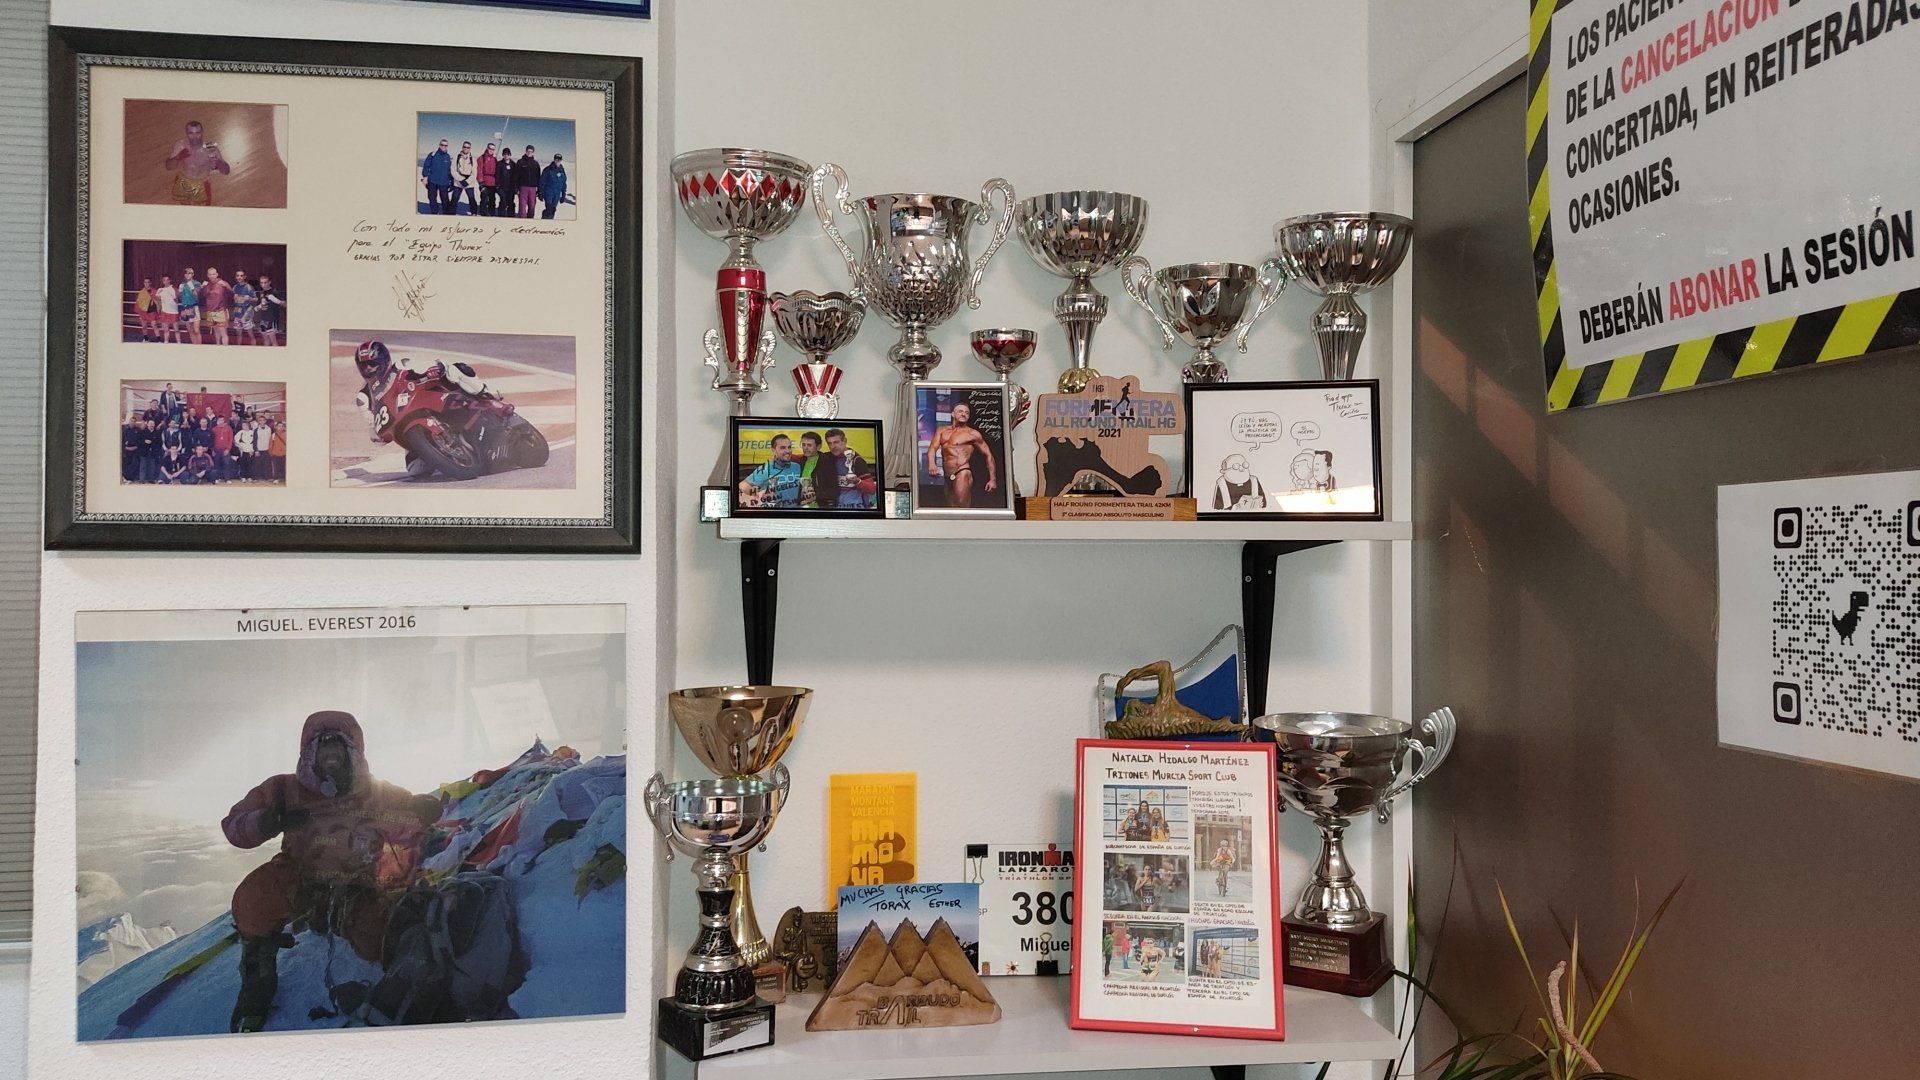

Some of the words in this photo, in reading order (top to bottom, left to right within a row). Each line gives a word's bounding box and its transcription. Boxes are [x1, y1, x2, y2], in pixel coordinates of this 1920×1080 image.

[1567, 19, 1600, 70] LOS
[1605, 0, 1682, 47] PACIEN
[1566, 81, 1588, 124] DE
[1593, 67, 1616, 110] LA
[1566, 86, 1698, 179] CONCERTADA,
[1705, 63, 1736, 115] EN
[1568, 156, 1680, 234] OCASIONES.
[387, 220, 410, 232] todo
[441, 222, 483, 240] esfuerzo
[489, 228, 501, 239] y
[383, 237, 396, 246] el
[1579, 283, 1664, 344] DEBERÁN
[1669, 258, 1760, 321] ABONAR
[1764, 246, 1799, 295] LA
[1804, 207, 1915, 285] SESIÓN
[1046, 399, 1176, 416] FORMENTERA
[1044, 416, 1069, 428] ALL
[1071, 416, 1116, 429] ROUND
[1119, 416, 1155, 429] TRAIL
[1158, 417, 1176, 429] HG
[1098, 428, 1121, 438] 2021
[237, 618, 303, 632] MIGUEL.
[308, 617, 374, 630] EVEREST
[379, 615, 416, 629] 2016
[999, 850, 1074, 867] IRONMA
[869, 899, 912, 912] TORAX
[928, 899, 962, 909] ESTHER
[1012, 891, 1074, 925] 380
